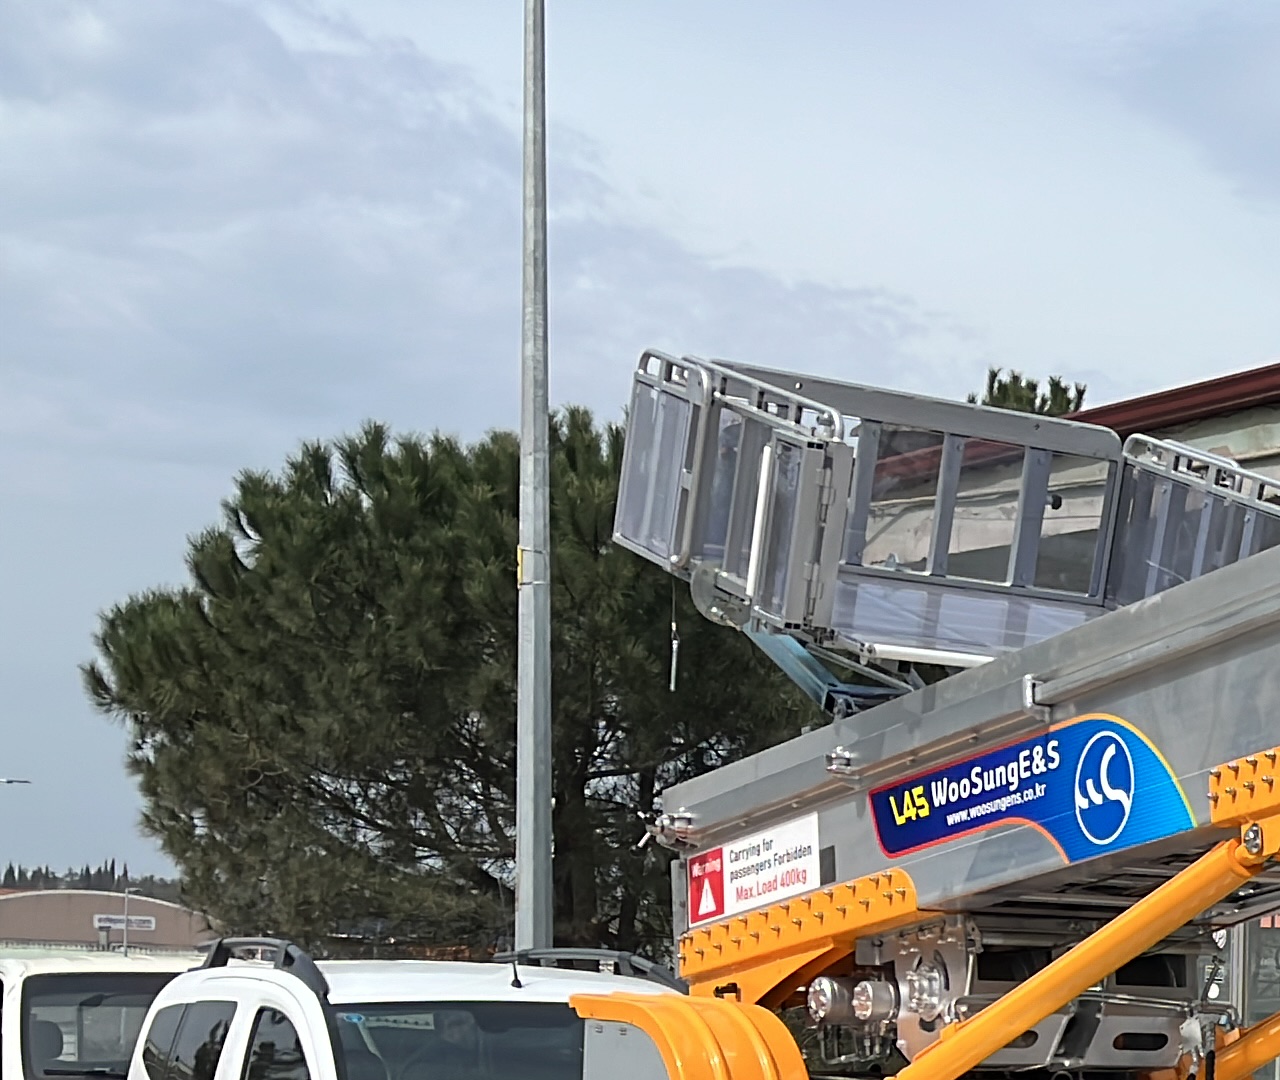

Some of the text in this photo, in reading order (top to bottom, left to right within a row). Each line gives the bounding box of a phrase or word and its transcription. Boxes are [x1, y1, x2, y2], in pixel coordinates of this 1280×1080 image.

[889, 740, 1061, 826] L45 WooSungE&S
[946, 783, 1047, 826] www.woosungens.co.kr
[729, 838, 774, 863] Carrying for
[730, 844, 812, 883] passengers Forbidden
[780, 868, 807, 888] 400kg
